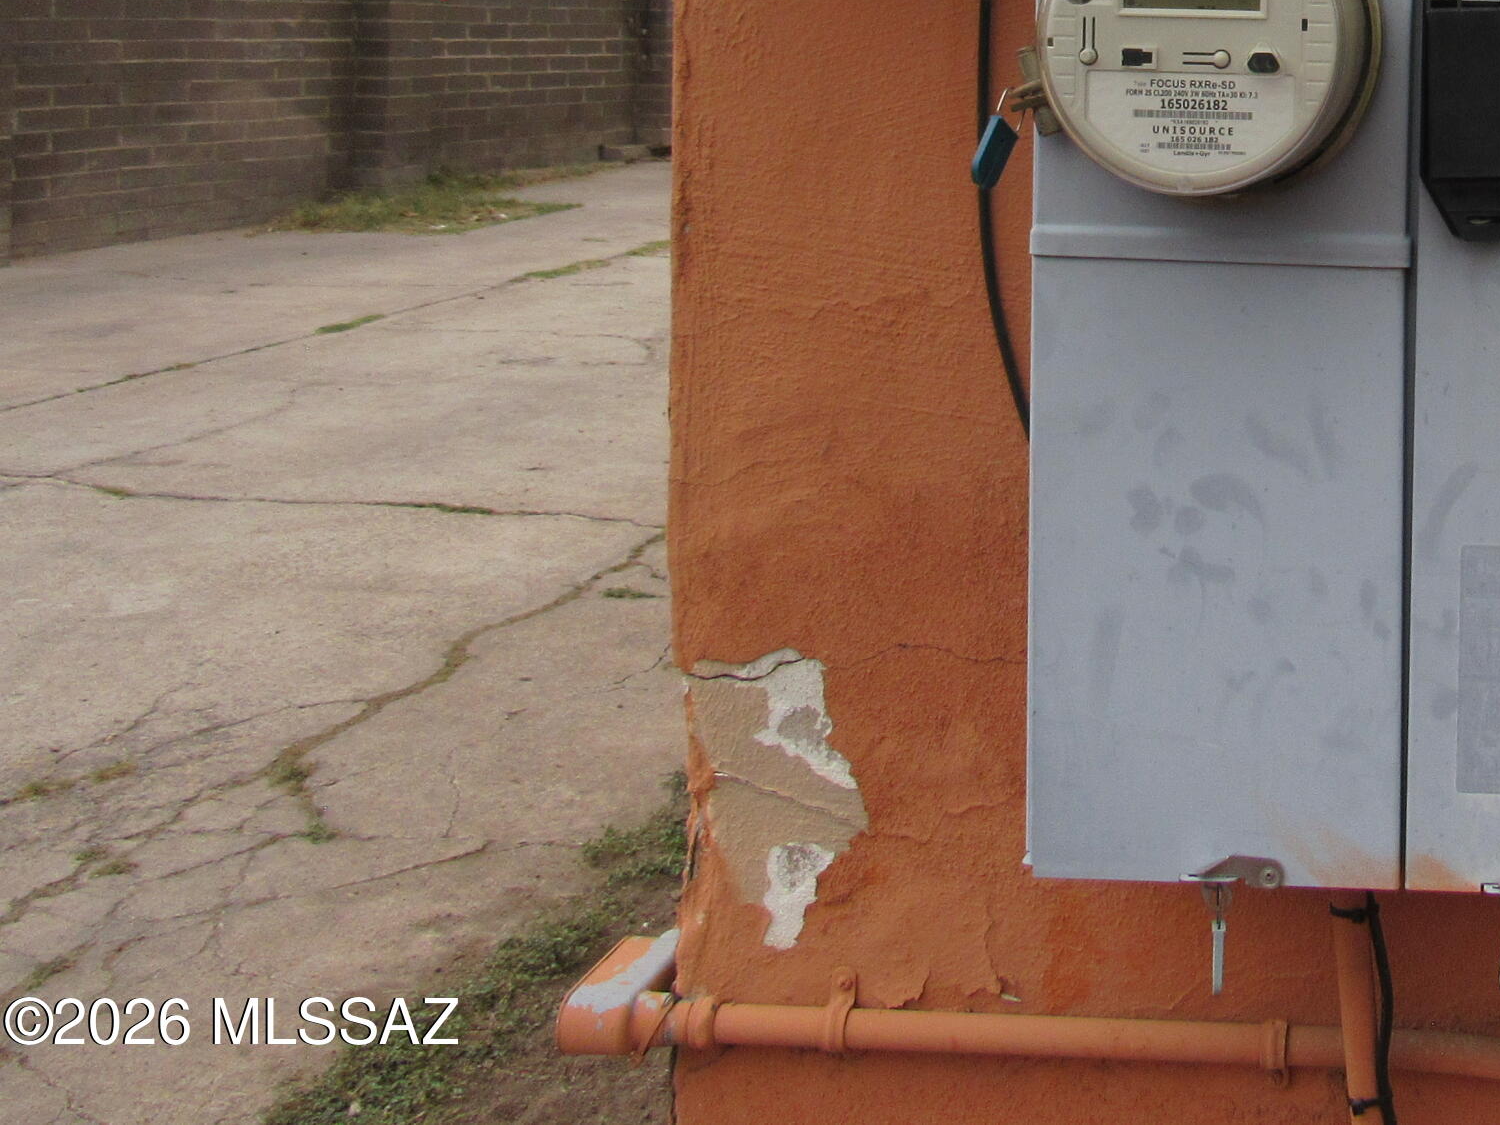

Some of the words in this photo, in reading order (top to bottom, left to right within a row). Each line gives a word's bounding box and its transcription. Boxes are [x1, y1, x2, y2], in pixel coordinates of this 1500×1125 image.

[1150, 79, 1186, 88] FOCUS
[1190, 80, 1236, 90] RXRe-SD
[1161, 98, 1228, 110] 165026182
[1153, 125, 1234, 135] UNISOURCE
